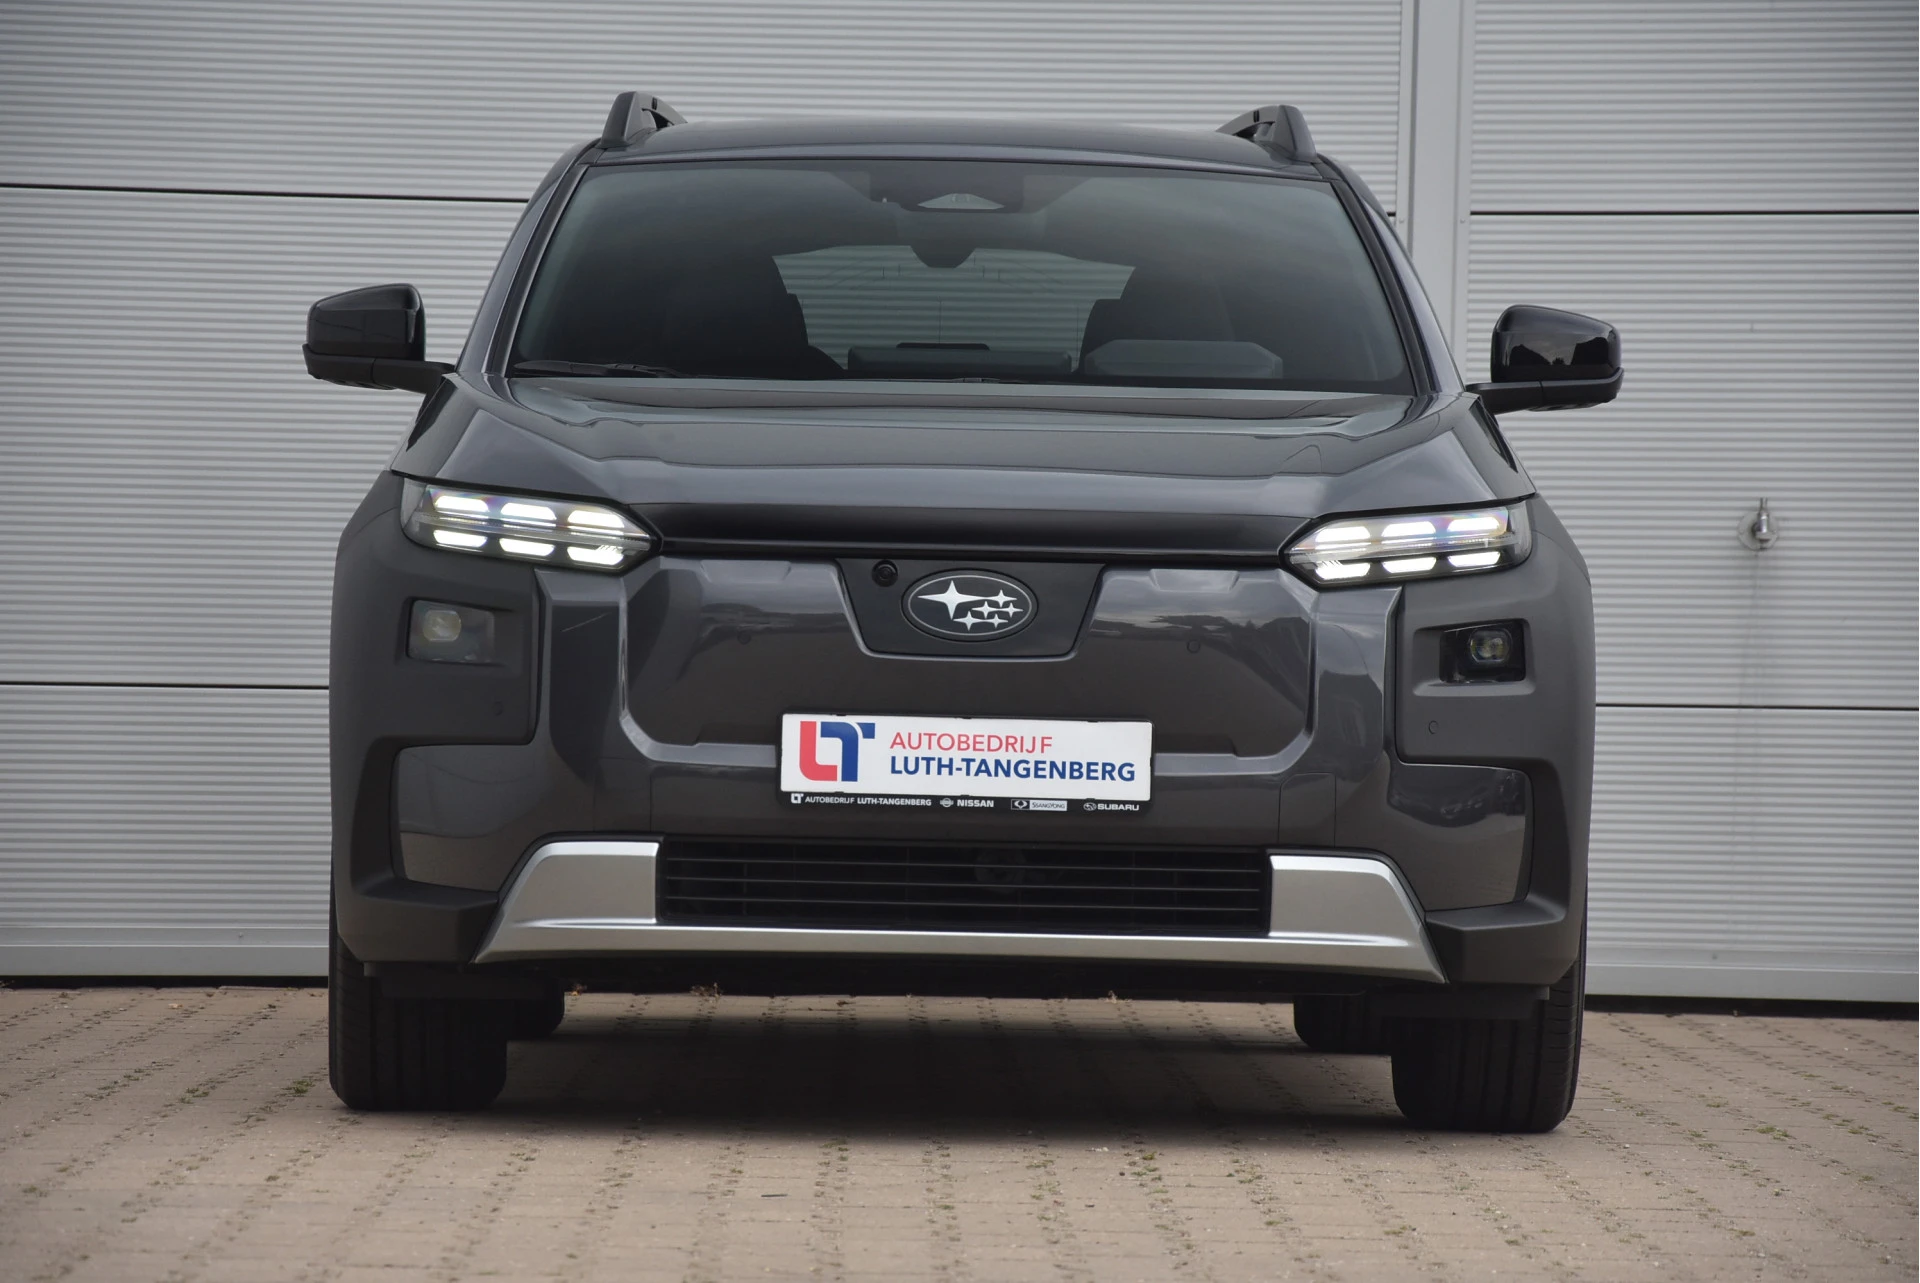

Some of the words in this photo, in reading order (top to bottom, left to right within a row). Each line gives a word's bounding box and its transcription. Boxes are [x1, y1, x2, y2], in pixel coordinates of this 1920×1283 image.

[889, 732, 1053, 753] AUTOBEDRIJF
[891, 756, 1136, 782] LUTH-TANGENBERG
[805, 796, 855, 804] AUTOBEDRIJF
[857, 797, 932, 806] LUTH-TANGENBERG
[957, 799, 994, 808] NISSAN
[1097, 803, 1140, 811] SUBARU
